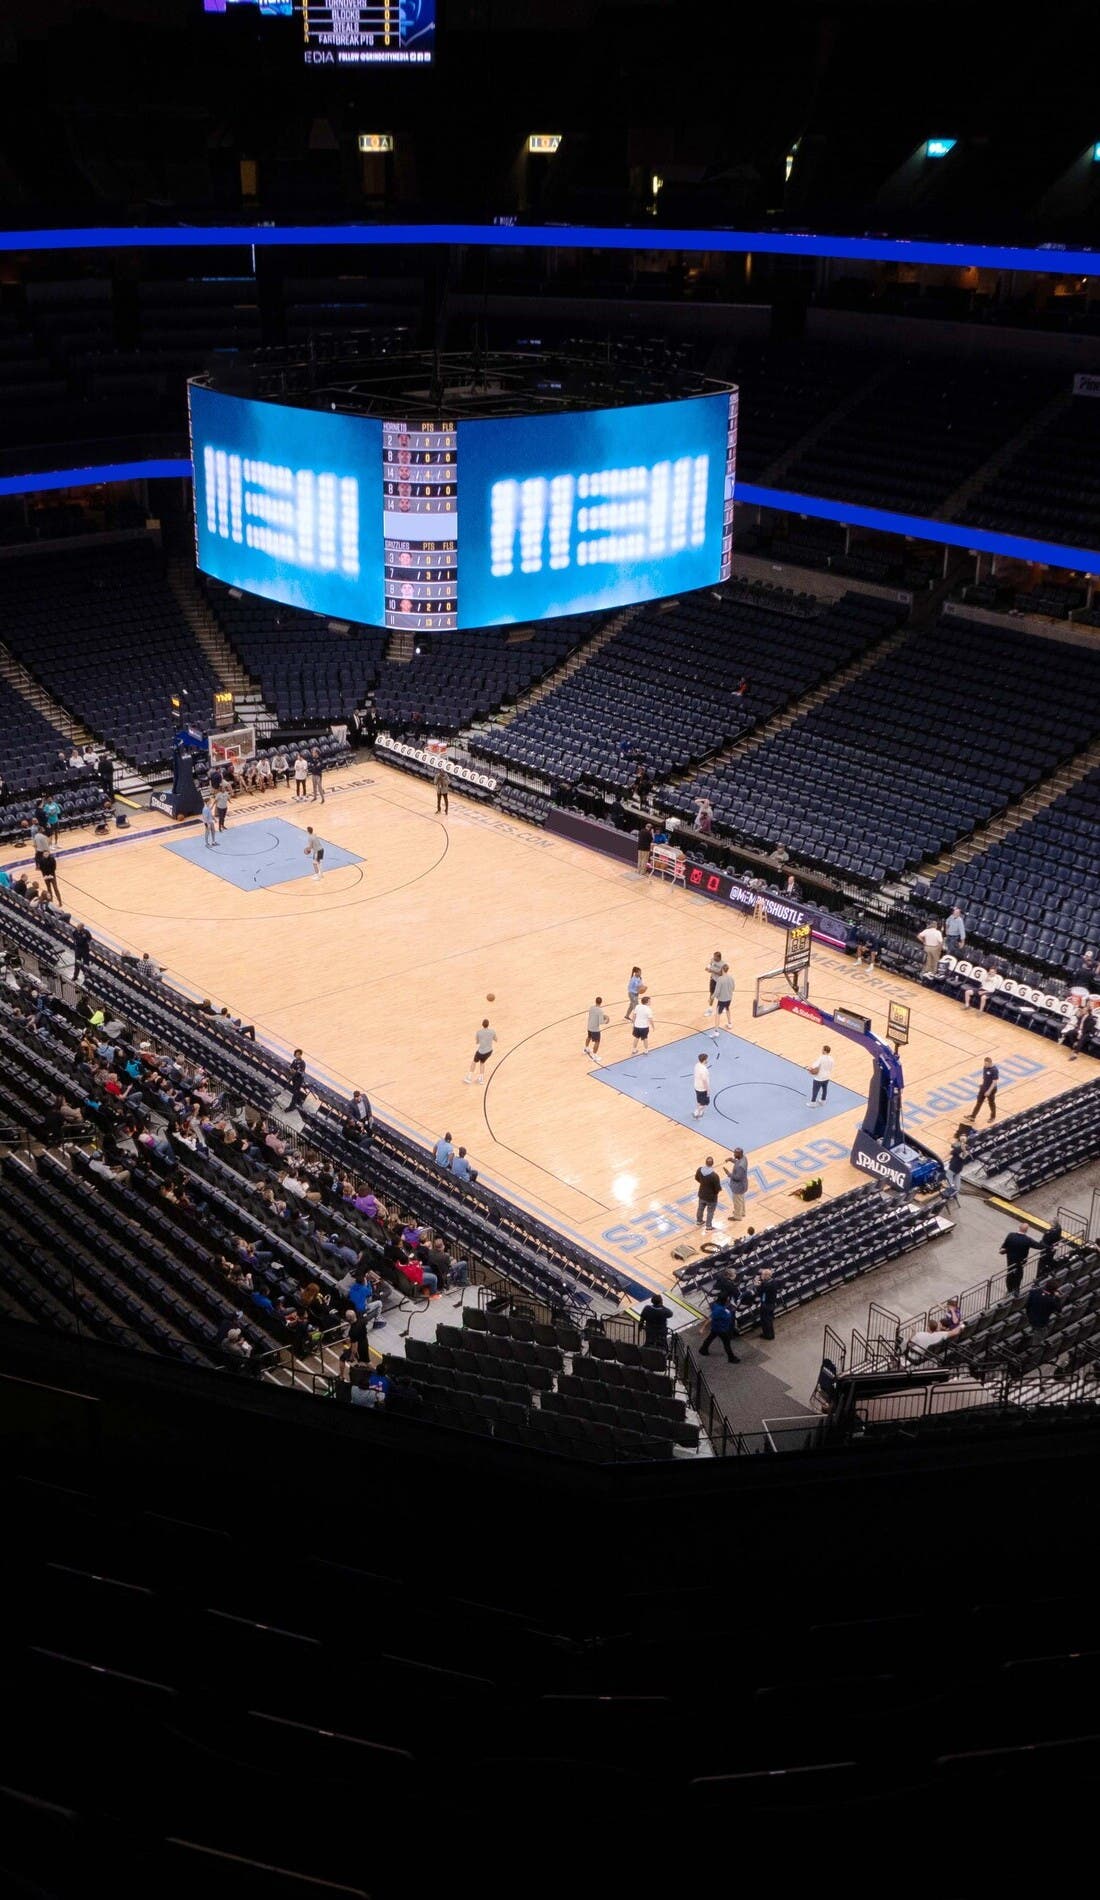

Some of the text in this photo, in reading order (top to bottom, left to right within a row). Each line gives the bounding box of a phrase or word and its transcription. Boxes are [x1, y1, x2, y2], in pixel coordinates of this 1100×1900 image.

[332, 10, 360, 20] BLOCKS
[422, 423, 434, 432] PTS
[388, 435, 392, 446] 2
[423, 542, 435, 550] PTS
[855, 1151, 906, 1190] SPALDING
